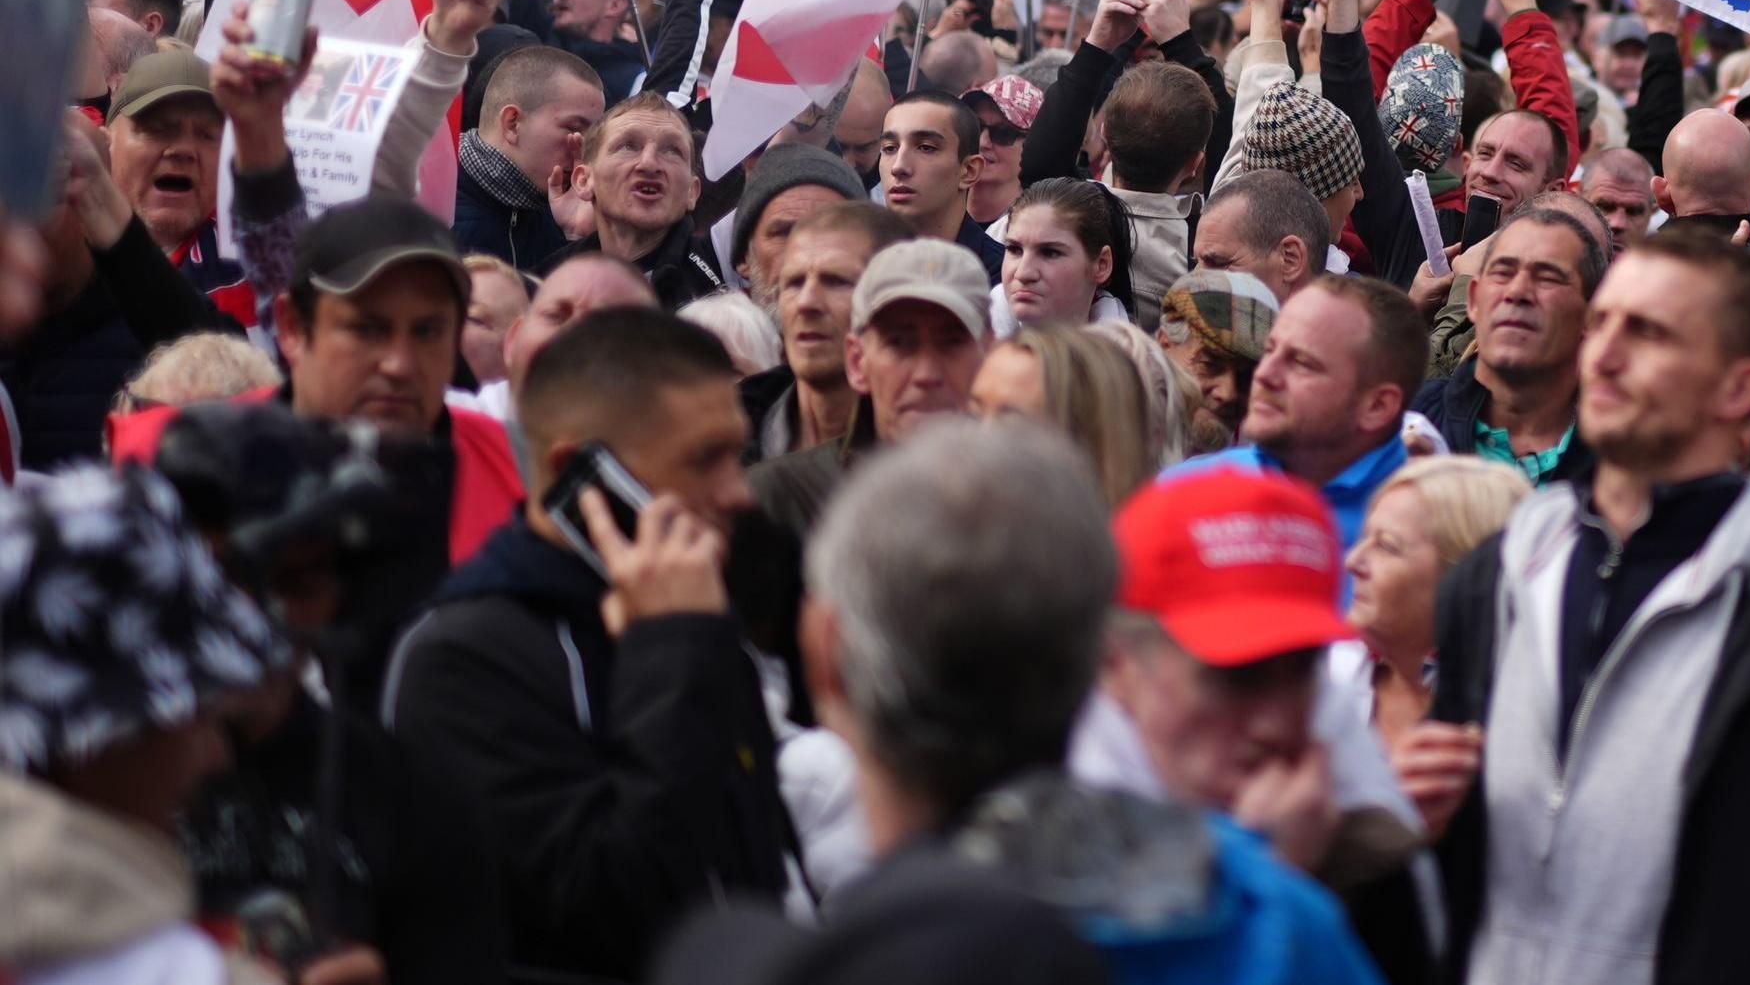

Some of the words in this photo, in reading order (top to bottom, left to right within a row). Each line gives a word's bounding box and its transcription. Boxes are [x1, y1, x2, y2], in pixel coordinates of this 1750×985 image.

[311, 149, 331, 161] For
[321, 170, 360, 185] Family
[688, 252, 721, 286] UNDER
